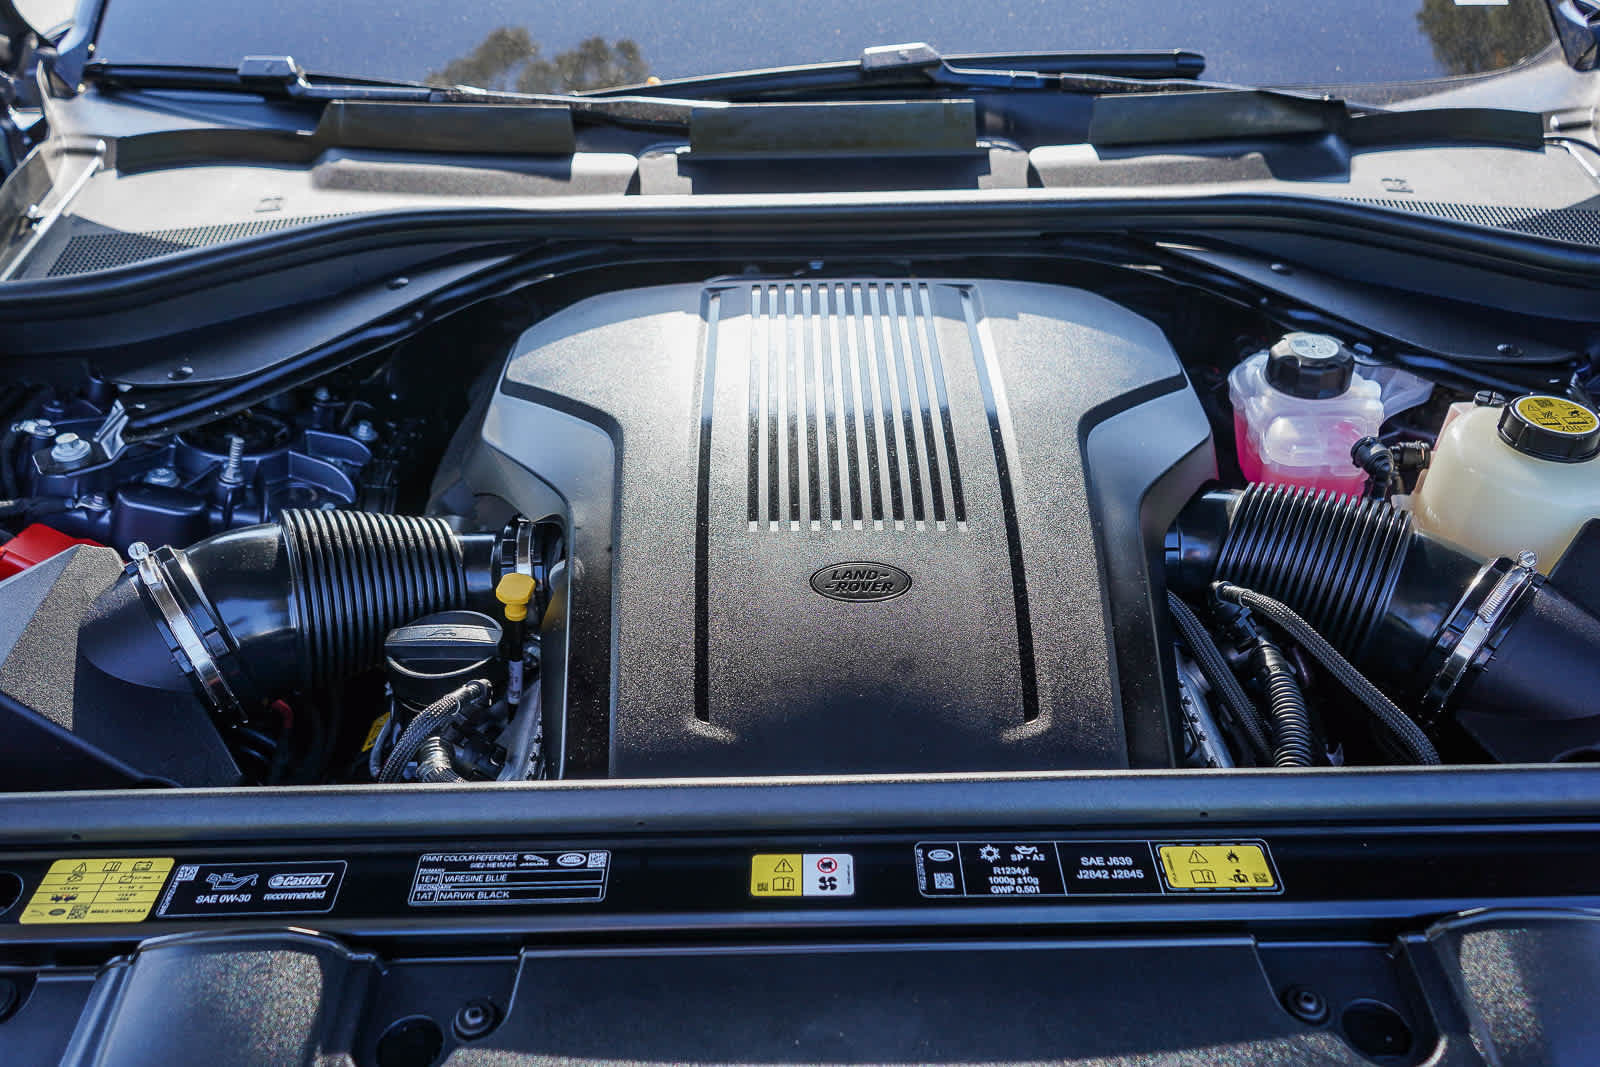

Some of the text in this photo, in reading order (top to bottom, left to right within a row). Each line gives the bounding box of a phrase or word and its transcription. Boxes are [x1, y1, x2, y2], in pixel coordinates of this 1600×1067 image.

[831, 570, 879, 580] LAND
[835, 581, 895, 592] ROVER
[422, 853, 519, 863] PAINT COLOUR REFERENCE
[1080, 856, 1134, 866] SAE J639
[420, 873, 508, 883] 1EH VARESINE BLUE
[1076, 870, 1110, 879] J2842
[283, 874, 326, 886] Castrol
[988, 876, 1016, 885] 1000g
[990, 885, 1041, 894] GWP 0.501
[195, 893, 253, 904] SAE 0W-30
[263, 890, 327, 901] recommended
[415, 890, 511, 900] 1AT NARVIK BLACK
